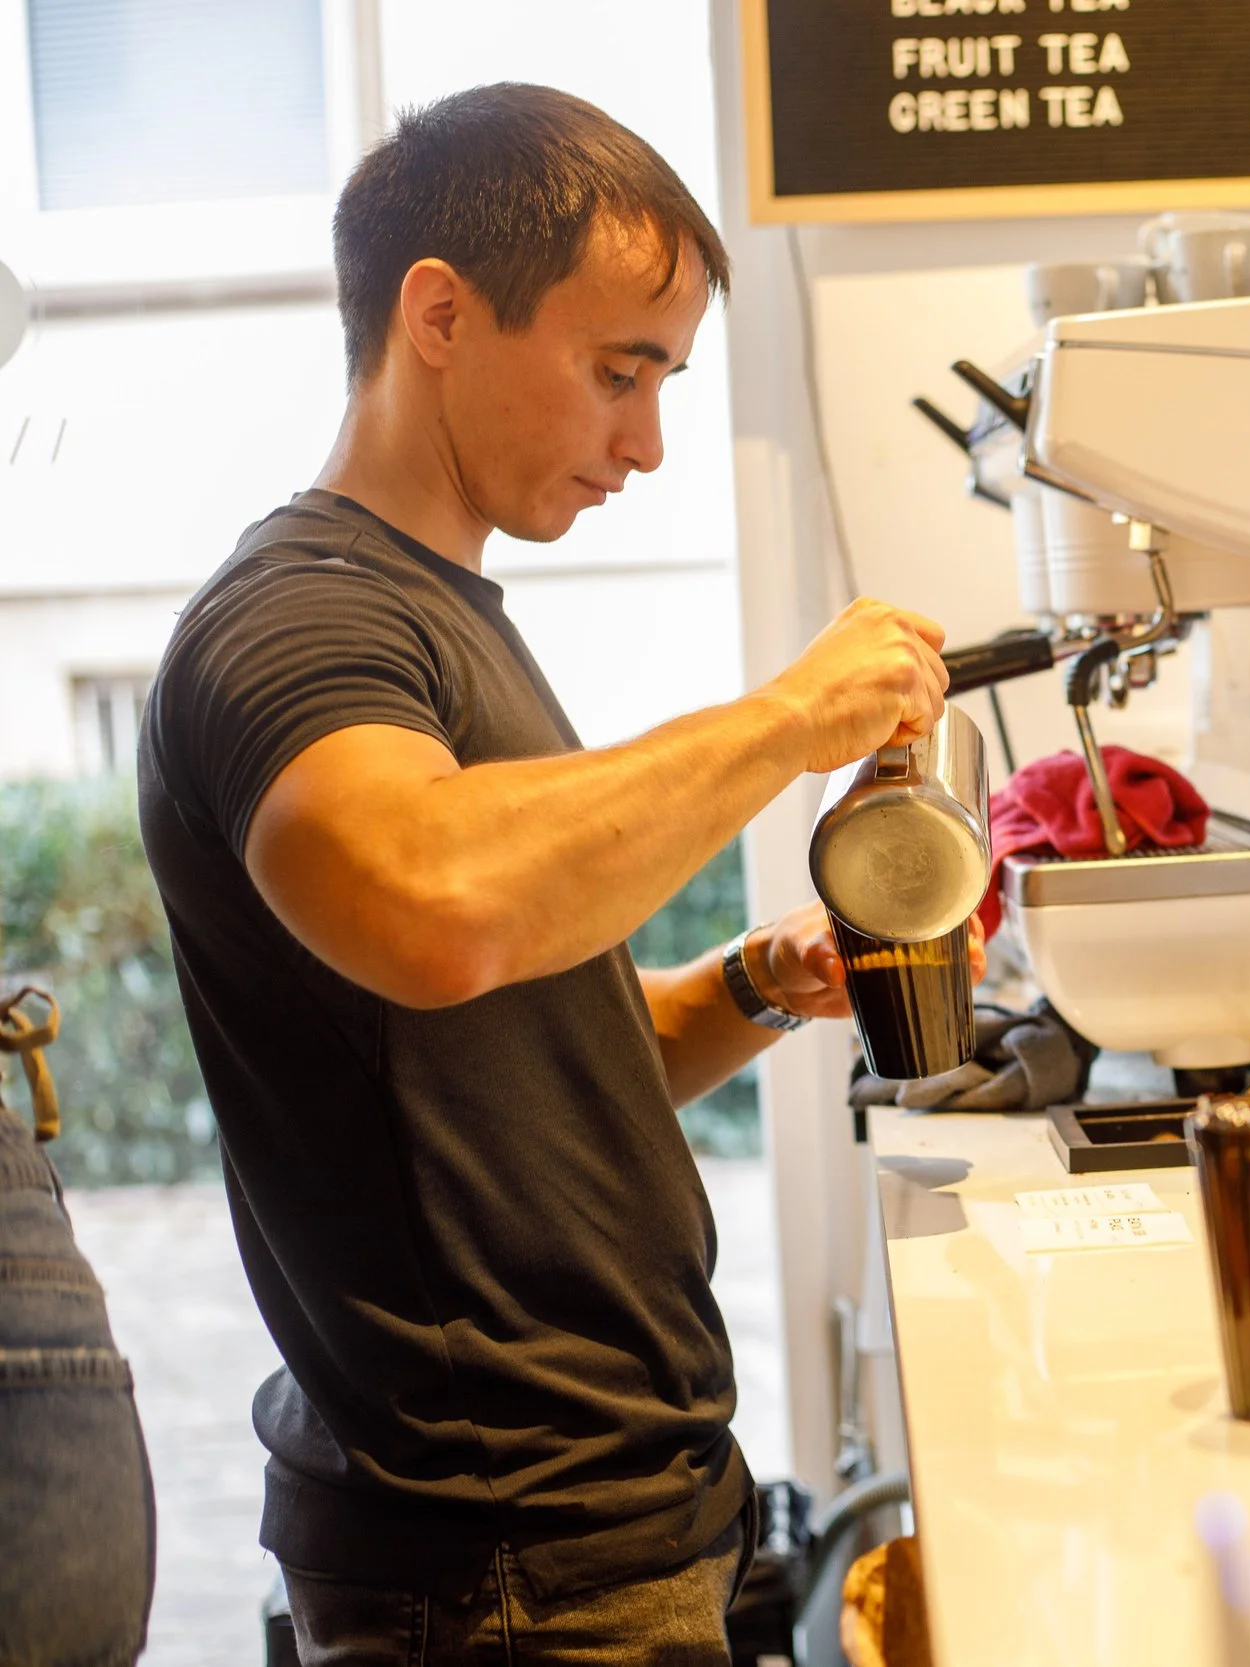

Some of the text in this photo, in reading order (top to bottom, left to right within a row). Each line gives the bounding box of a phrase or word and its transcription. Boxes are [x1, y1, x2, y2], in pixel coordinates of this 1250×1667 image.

[892, 35, 1022, 80] FRUIT
[1038, 32, 1129, 75] TEA
[888, 87, 1030, 133] GREEN
[1038, 85, 1123, 128] TEA
